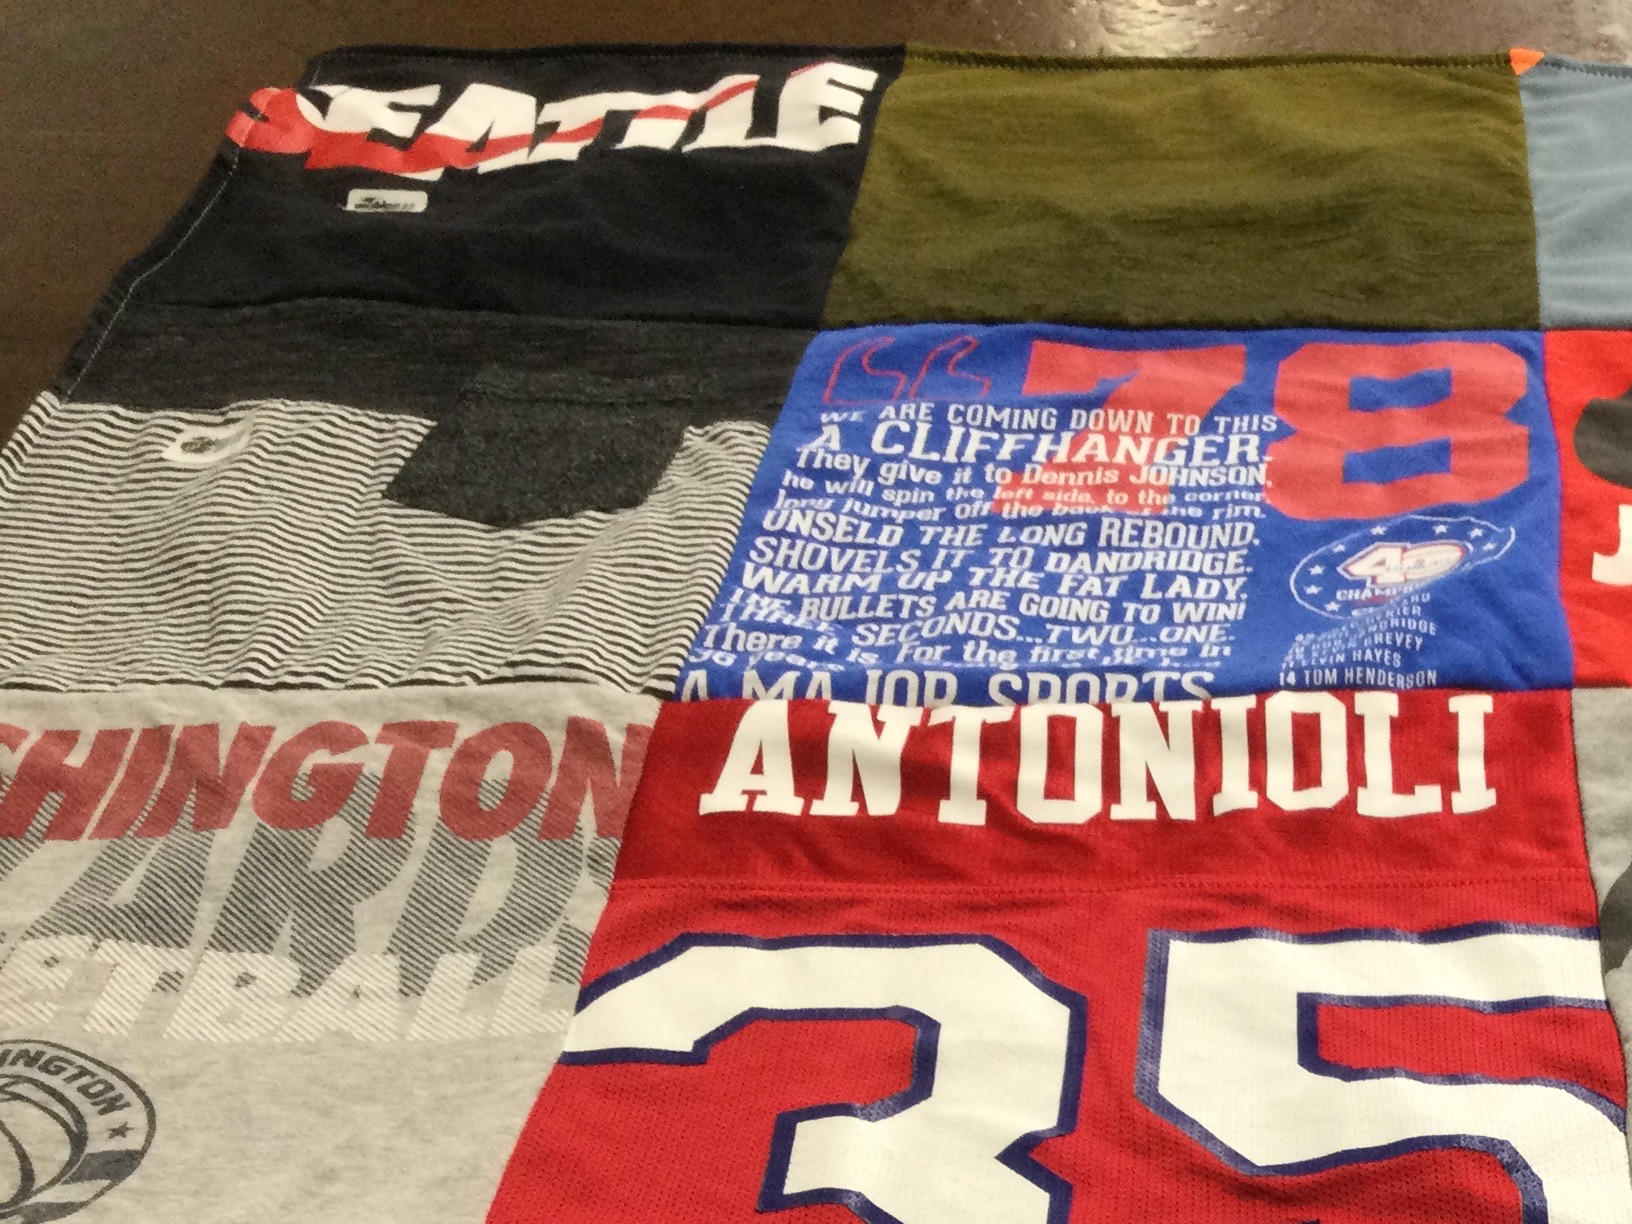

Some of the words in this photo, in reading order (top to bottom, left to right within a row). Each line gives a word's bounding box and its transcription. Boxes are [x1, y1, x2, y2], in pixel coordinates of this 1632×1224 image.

[226, 61, 879, 181] SEATTLE
[879, 402, 935, 421] ARE
[947, 404, 1058, 431] COMING
[1069, 408, 1155, 434] DOWN
[1166, 412, 1201, 436] TO
[1214, 414, 1278, 434] THIS
[797, 423, 841, 451] A
[871, 419, 1274, 467] CLIFFHANGER.
[782, 469, 815, 490] he
[825, 476, 875, 497] will
[881, 487, 936, 507] spin
[946, 486, 985, 501] the
[992, 483, 1034, 501] left
[1106, 489, 1130, 505] to
[1137, 489, 1176, 505] the
[796, 447, 871, 480] They
[877, 460, 943, 486] give
[952, 466, 973, 484] it
[985, 462, 1012, 485] to
[1021, 463, 1120, 486] Dennis
[1128, 464, 1273, 488] JOHNSON,
[761, 508, 905, 548] UNSELD
[919, 523, 989, 547] THE
[996, 521, 1088, 547] LONG
[1097, 516, 1261, 550] REBOUND.
[840, 497, 947, 523] jumper
[1001, 500, 1045, 519] the
[748, 536, 922, 574] SHOVELS
[931, 548, 975, 571] IT
[990, 546, 1036, 571] TO
[1043, 548, 1255, 577] DANDRIDGE.
[741, 561, 883, 595] WARM
[897, 569, 953, 592] UP
[968, 566, 1045, 591] THE
[1057, 573, 1130, 598] FAT
[1139, 573, 1249, 601] LADY.
[799, 593, 938, 623] BULLETS
[944, 588, 1012, 611] ARE
[1018, 592, 1112, 624] GOING
[1121, 601, 1162, 625] TO
[1171, 602, 1247, 624] WIN!
[703, 621, 804, 653] There
[846, 647, 880, 665] is
[1352, 648, 1402, 668] HAYES
[1278, 670, 1297, 687] 14
[1304, 668, 1338, 688] TOM
[1344, 666, 1438, 690] HENDERSON
[0, 715, 653, 841] HINGTON
[699, 690, 1497, 826] ANTONIOLI
